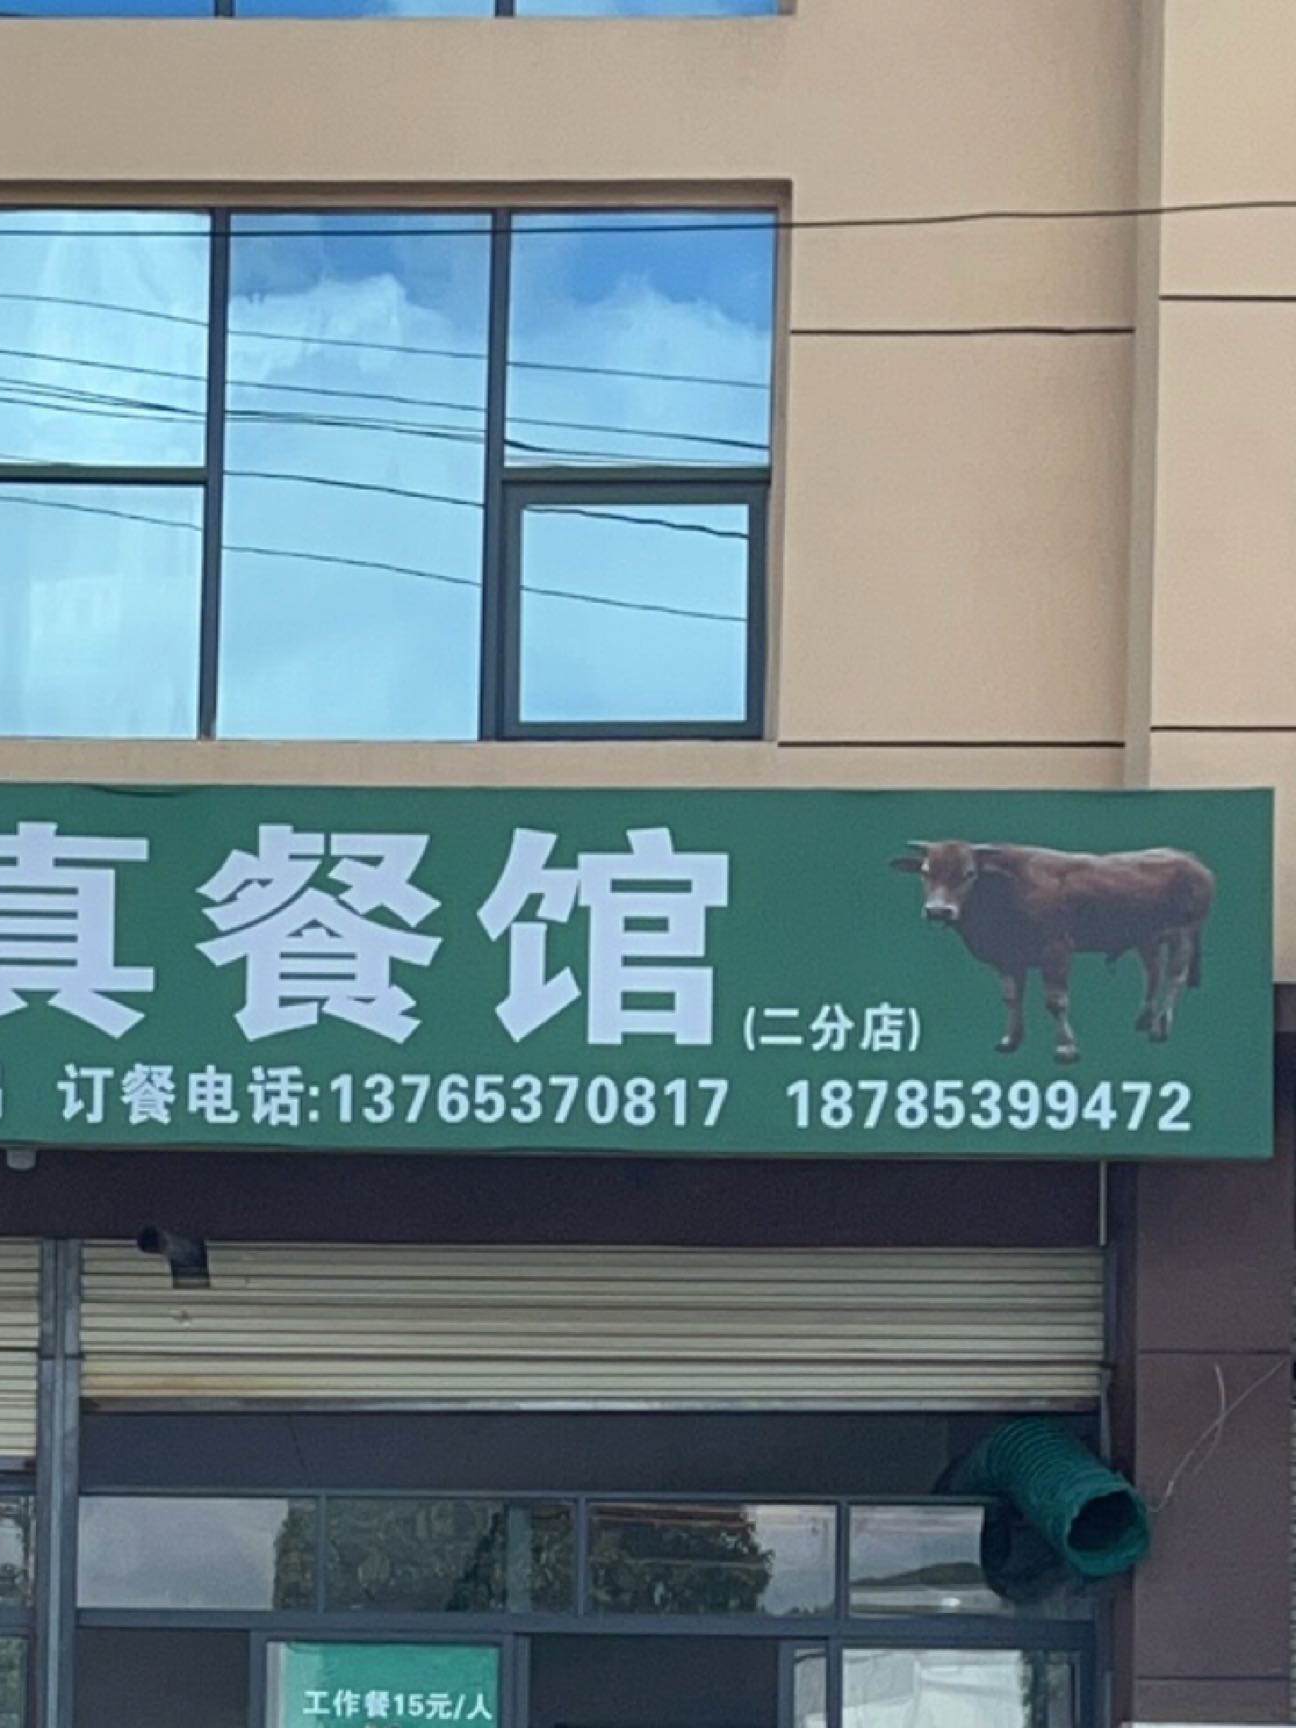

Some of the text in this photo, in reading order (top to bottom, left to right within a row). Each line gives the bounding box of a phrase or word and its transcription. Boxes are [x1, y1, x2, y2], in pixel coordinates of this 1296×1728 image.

[743, 1003, 921, 1053] (二分店)
[784, 1078, 1193, 1132] 18785399472
[302, 1688, 493, 1721] 工作餐15元/人
